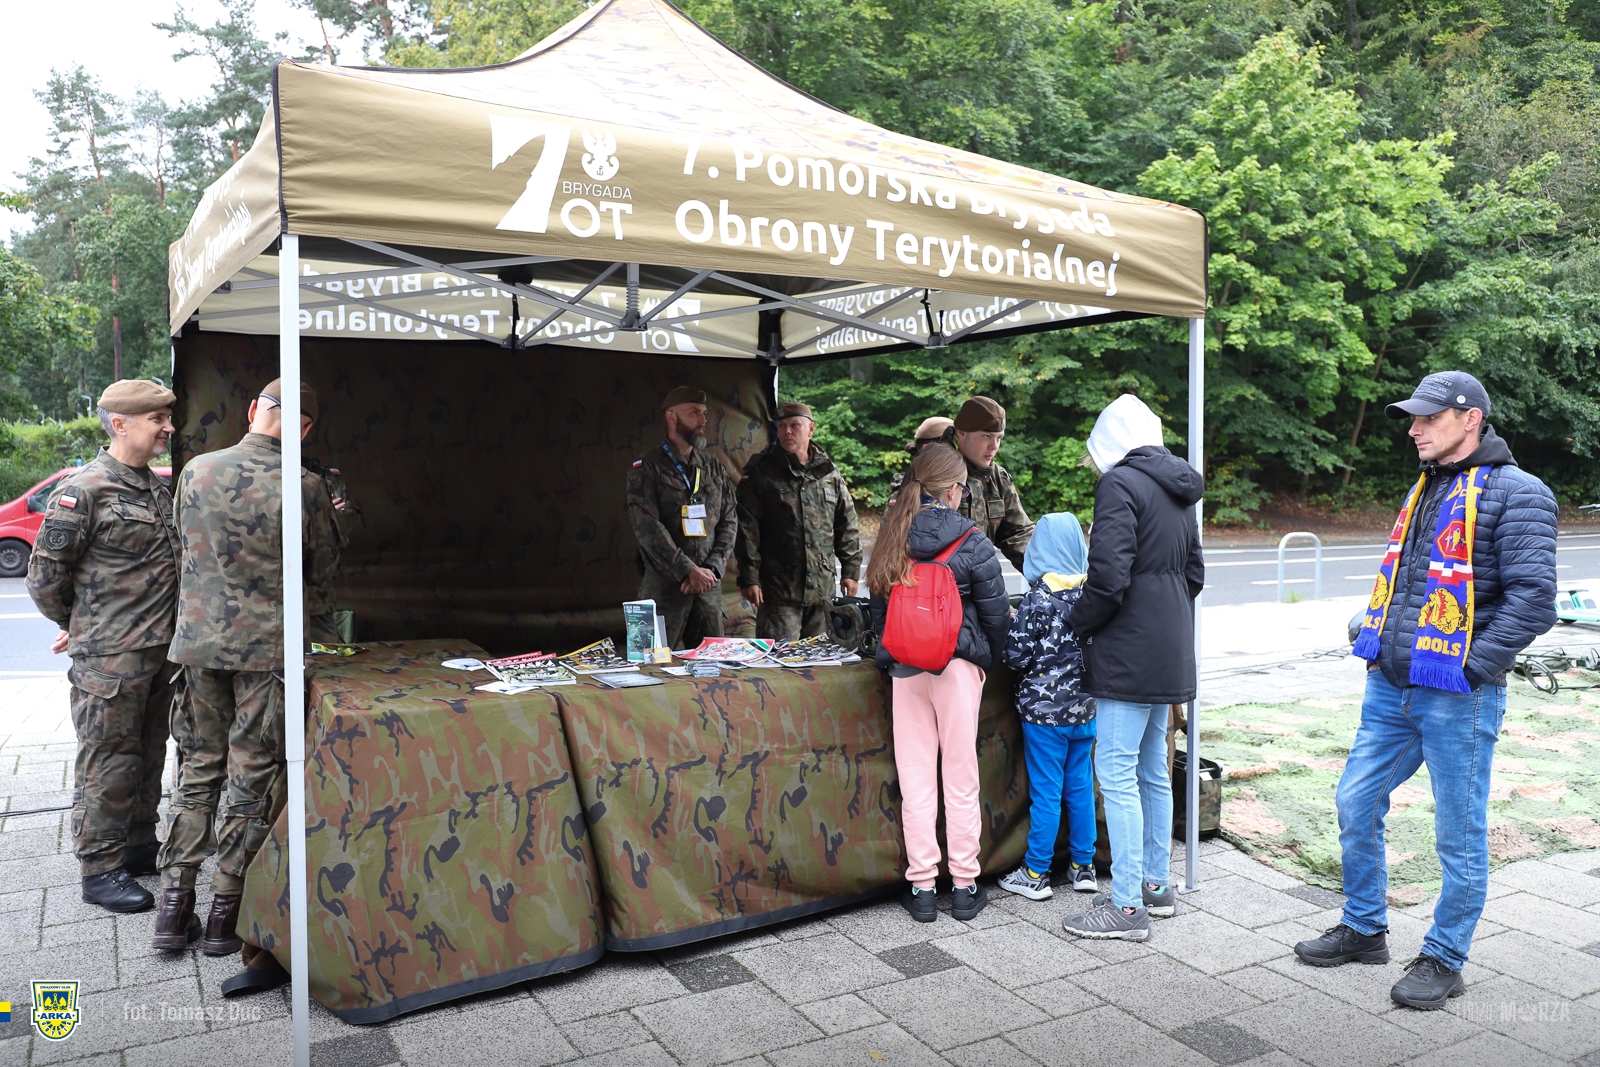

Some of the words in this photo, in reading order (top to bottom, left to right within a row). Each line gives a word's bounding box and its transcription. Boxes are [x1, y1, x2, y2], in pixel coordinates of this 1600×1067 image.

[488, 114, 571, 234] 7
[562, 180, 632, 200] BRYGADA
[732, 138, 956, 210] Pomorska
[560, 198, 633, 241] OT
[674, 199, 855, 266] Obrony
[866, 219, 1121, 297] Terytorialnej
